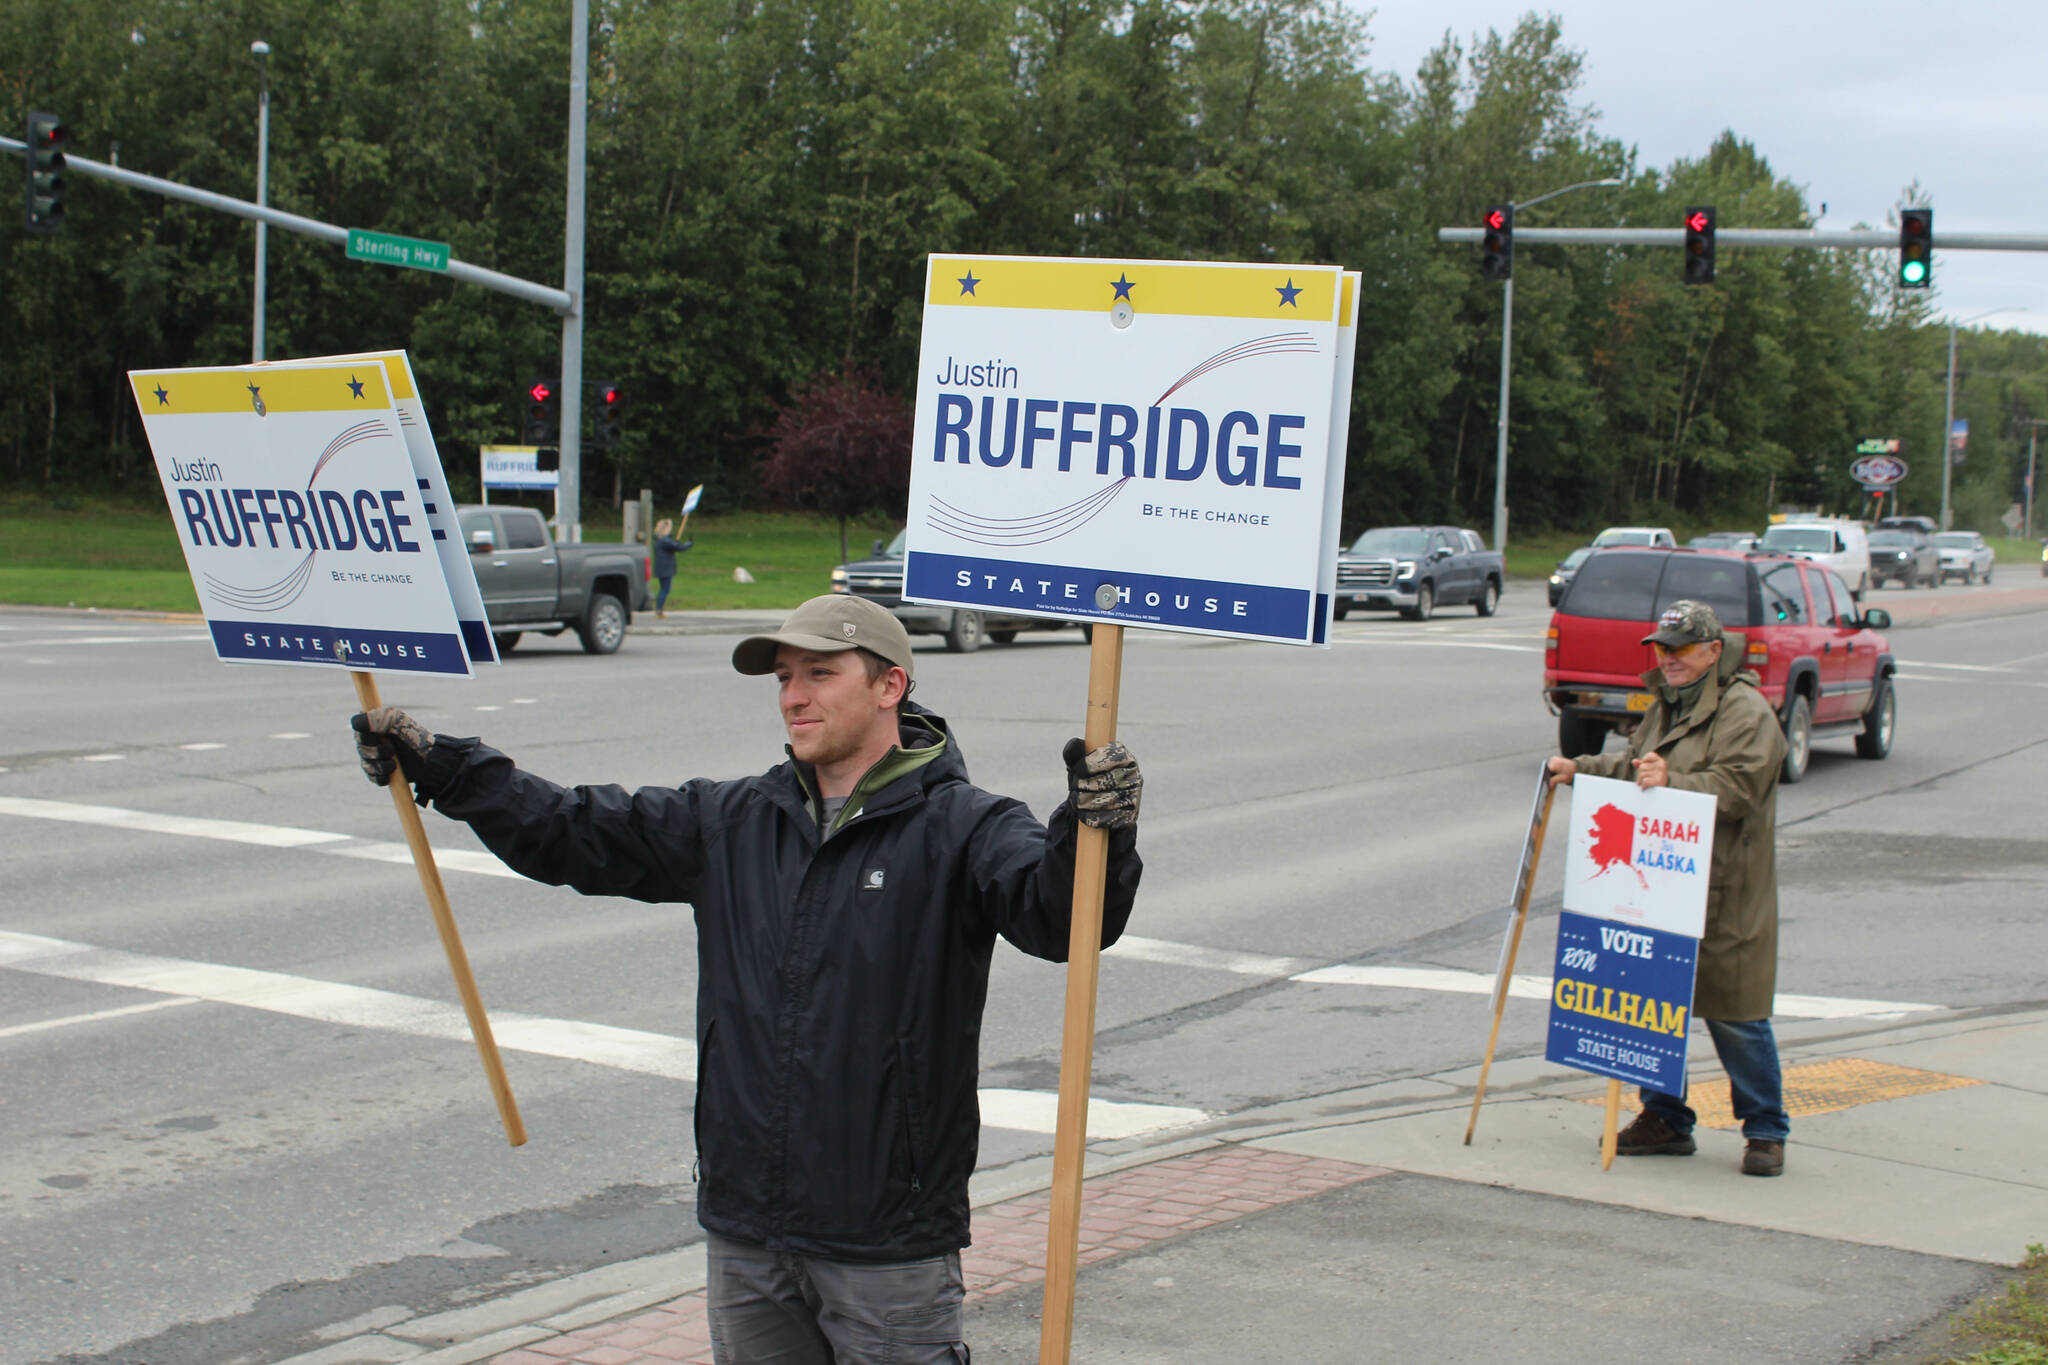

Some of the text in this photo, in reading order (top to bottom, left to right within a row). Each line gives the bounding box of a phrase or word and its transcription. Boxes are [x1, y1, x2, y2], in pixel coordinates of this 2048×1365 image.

[356, 237, 439, 267] Sterling Hwy
[937, 356, 1018, 389] Justin
[933, 393, 1306, 491] RUFFRIDGE
[170, 457, 223, 483] Justin
[178, 488, 421, 553] RUFFRIDGE
[1143, 504, 1270, 526] BE THE CHANGE
[331, 570, 413, 584] BE THE CHANGE
[956, 570, 1248, 618] STATE HOUSE
[244, 633, 427, 659] STATE HOUSE
[1639, 816, 1700, 844] SARAH
[1636, 849, 1697, 876] ALASKA
[1600, 926, 1654, 960] VOTE
[1554, 977, 1688, 1039] GILLHAM
[1576, 1037, 1617, 1062] STATE
[1617, 1047, 1661, 1073] HOUSE
